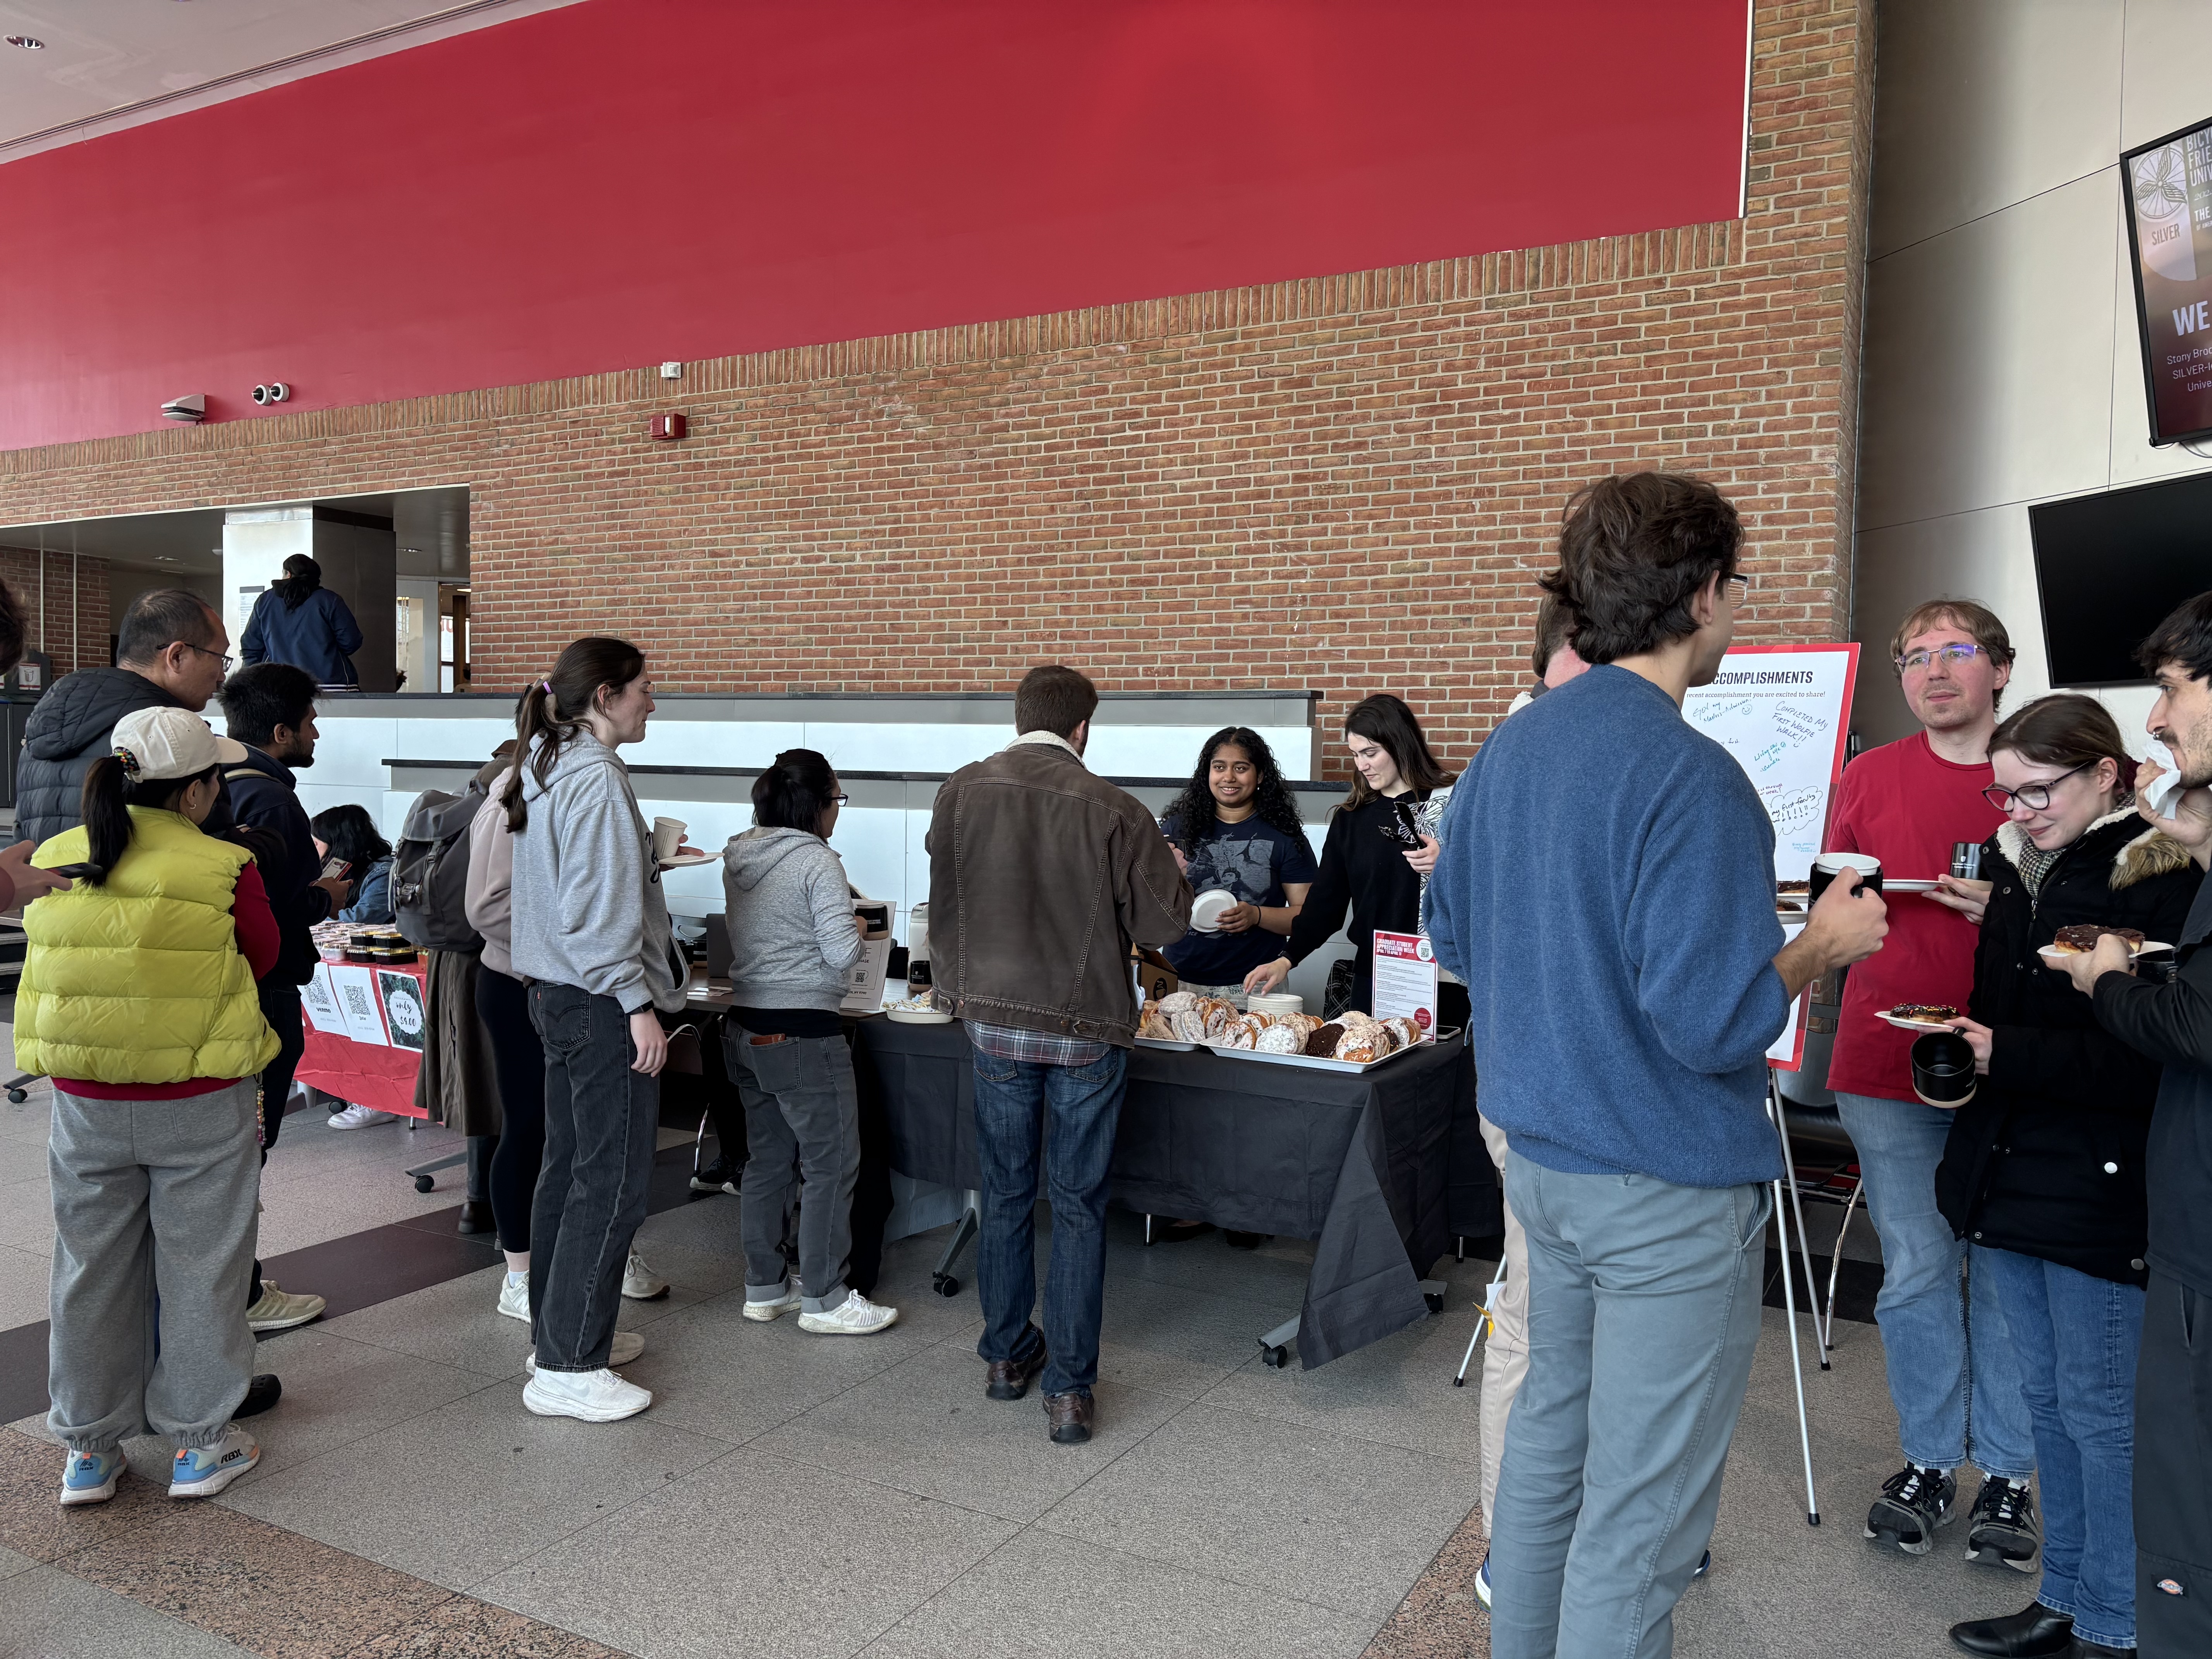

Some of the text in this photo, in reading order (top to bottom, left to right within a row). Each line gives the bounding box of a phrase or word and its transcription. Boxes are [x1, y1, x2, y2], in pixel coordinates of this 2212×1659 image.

[2186, 126, 2212, 152] BICY
[2188, 146, 2212, 169] FRIE
[2190, 163, 2212, 186] UNIV
[2194, 189, 2212, 201] 202
[2194, 206, 2210, 222] THE
[2152, 223, 2180, 246] SILVER
[2172, 301, 2210, 336] WE
[2167, 347, 2212, 364] Stony Broo
[2172, 362, 2212, 379] SILVER-l
[2188, 380, 2212, 392] Unive
[1712, 671, 1813, 684] CCOMPLISHMENTS
[1776, 701, 1812, 723] COMPLETED
[1772, 713, 1815, 737] FIRST WOLFIE
[1377, 943, 1403, 952] APPRECIATION
[221, 1449, 243, 1464] RBX
